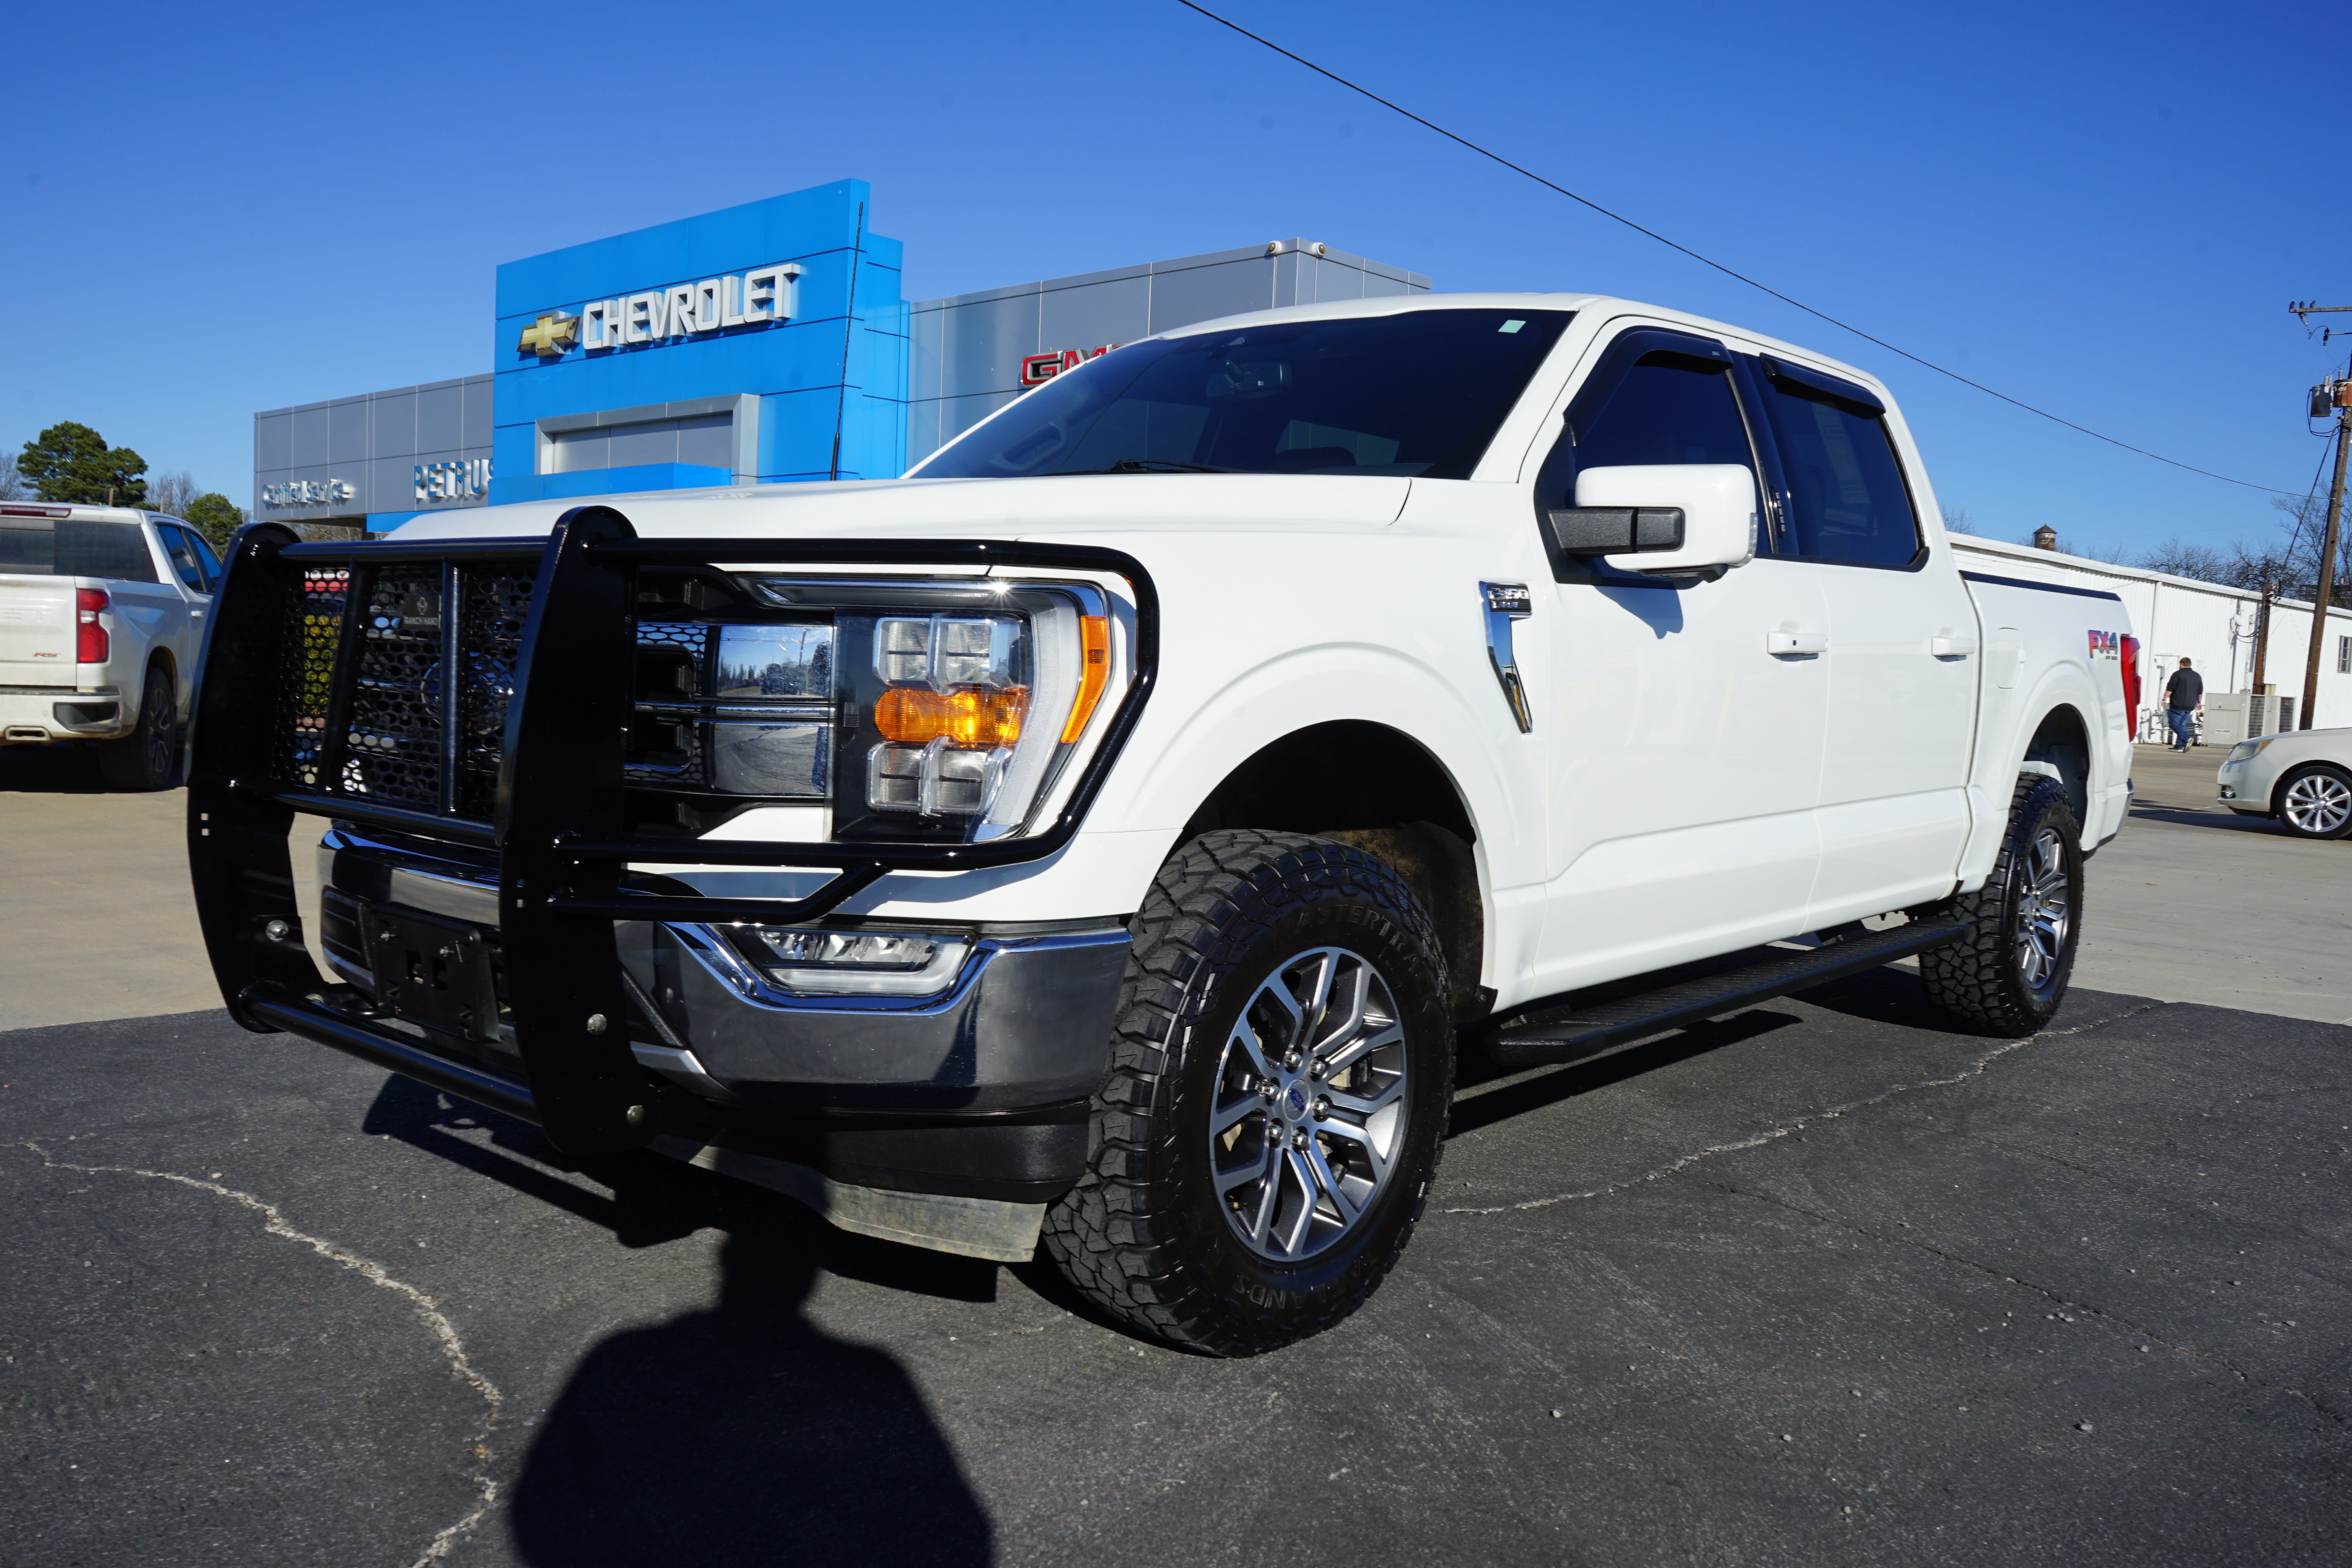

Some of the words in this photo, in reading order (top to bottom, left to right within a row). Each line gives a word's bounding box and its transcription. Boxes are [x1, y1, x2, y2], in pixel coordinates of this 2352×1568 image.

[583, 263, 800, 350] CHEVROLET
[1020, 342, 1133, 387] GM
[263, 480, 306, 505] Certified
[306, 478, 351, 502] Service
[2088, 629, 2118, 659] FX4
